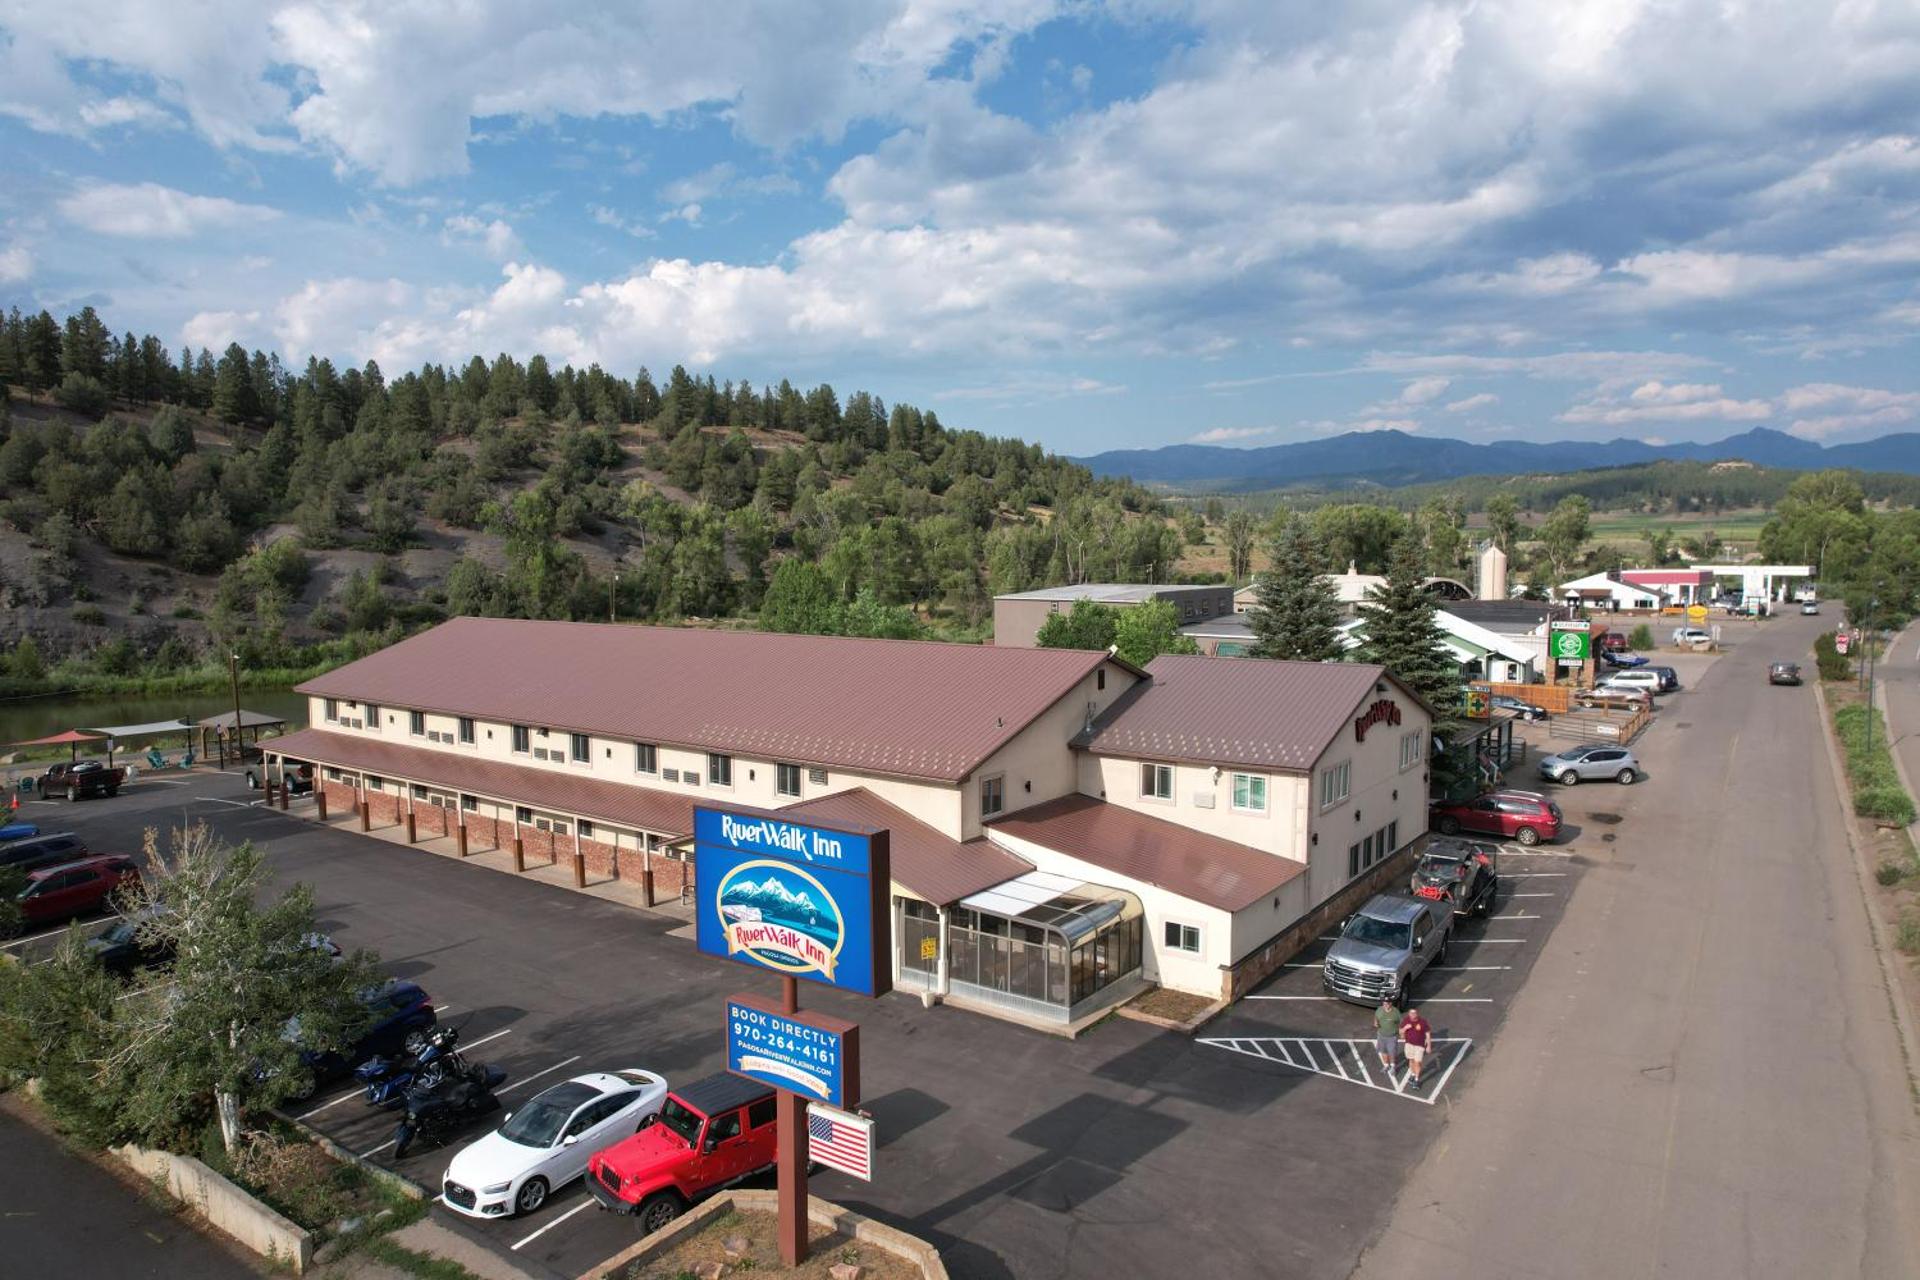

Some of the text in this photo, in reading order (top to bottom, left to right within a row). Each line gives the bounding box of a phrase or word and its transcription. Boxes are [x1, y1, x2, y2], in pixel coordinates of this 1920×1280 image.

[722, 815, 842, 861] RiverWalk Inn
[736, 926, 805, 958] RiverWalk
[806, 939, 826, 966] Inn
[732, 1007, 836, 1048] BOOK DIRECTLY
[734, 1023, 836, 1066] 970-264-4161
